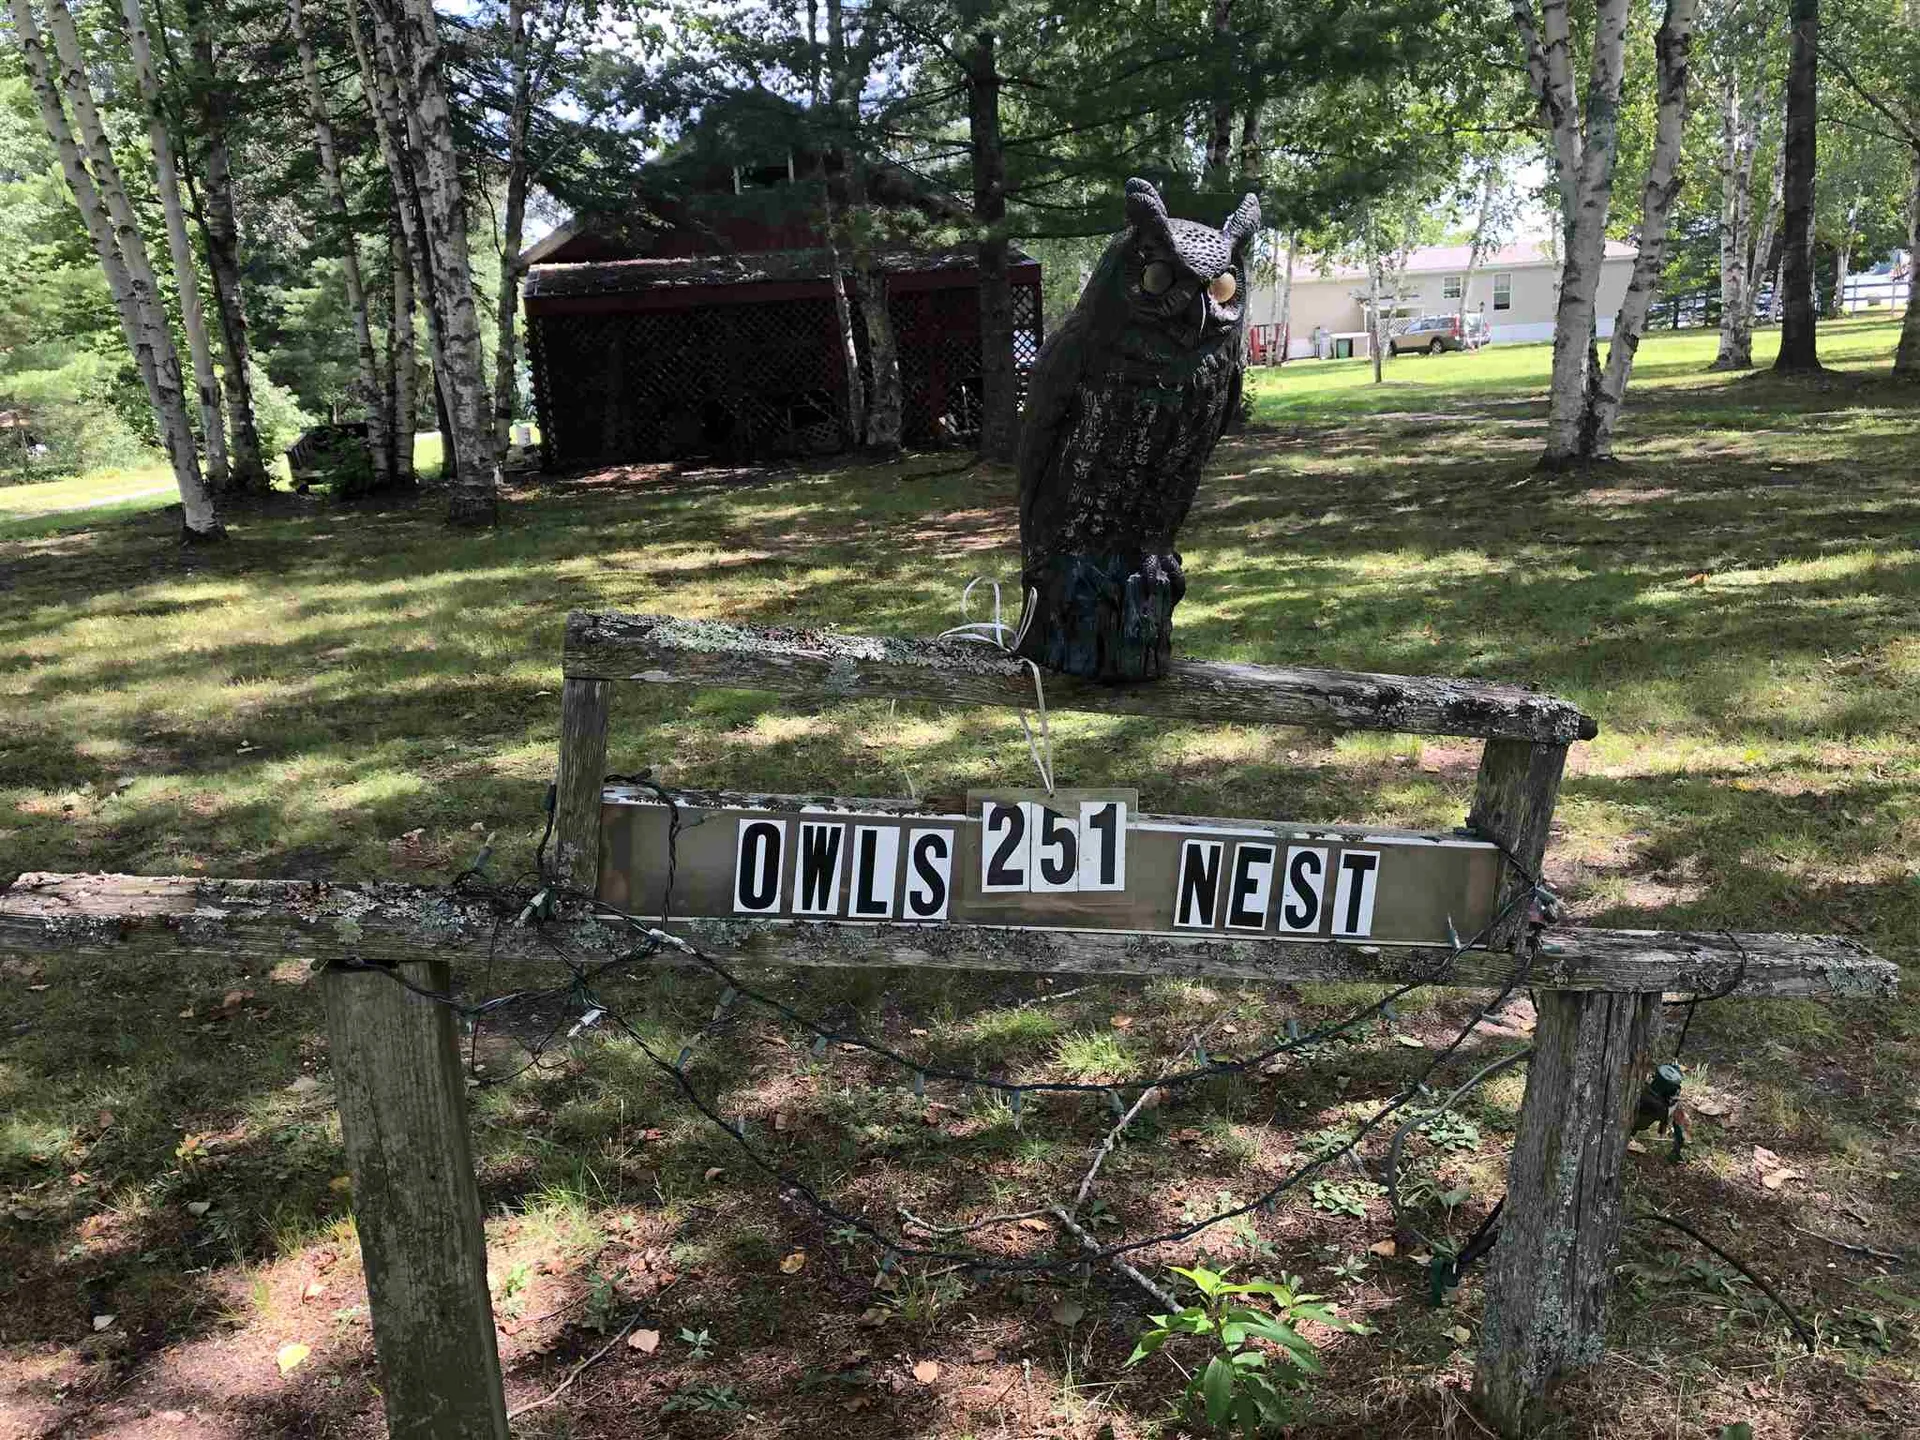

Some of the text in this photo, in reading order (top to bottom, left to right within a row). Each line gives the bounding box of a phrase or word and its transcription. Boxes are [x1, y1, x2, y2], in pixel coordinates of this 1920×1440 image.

[738, 821, 1378, 934] OWLS NEST
[986, 802, 1117, 886] 251
